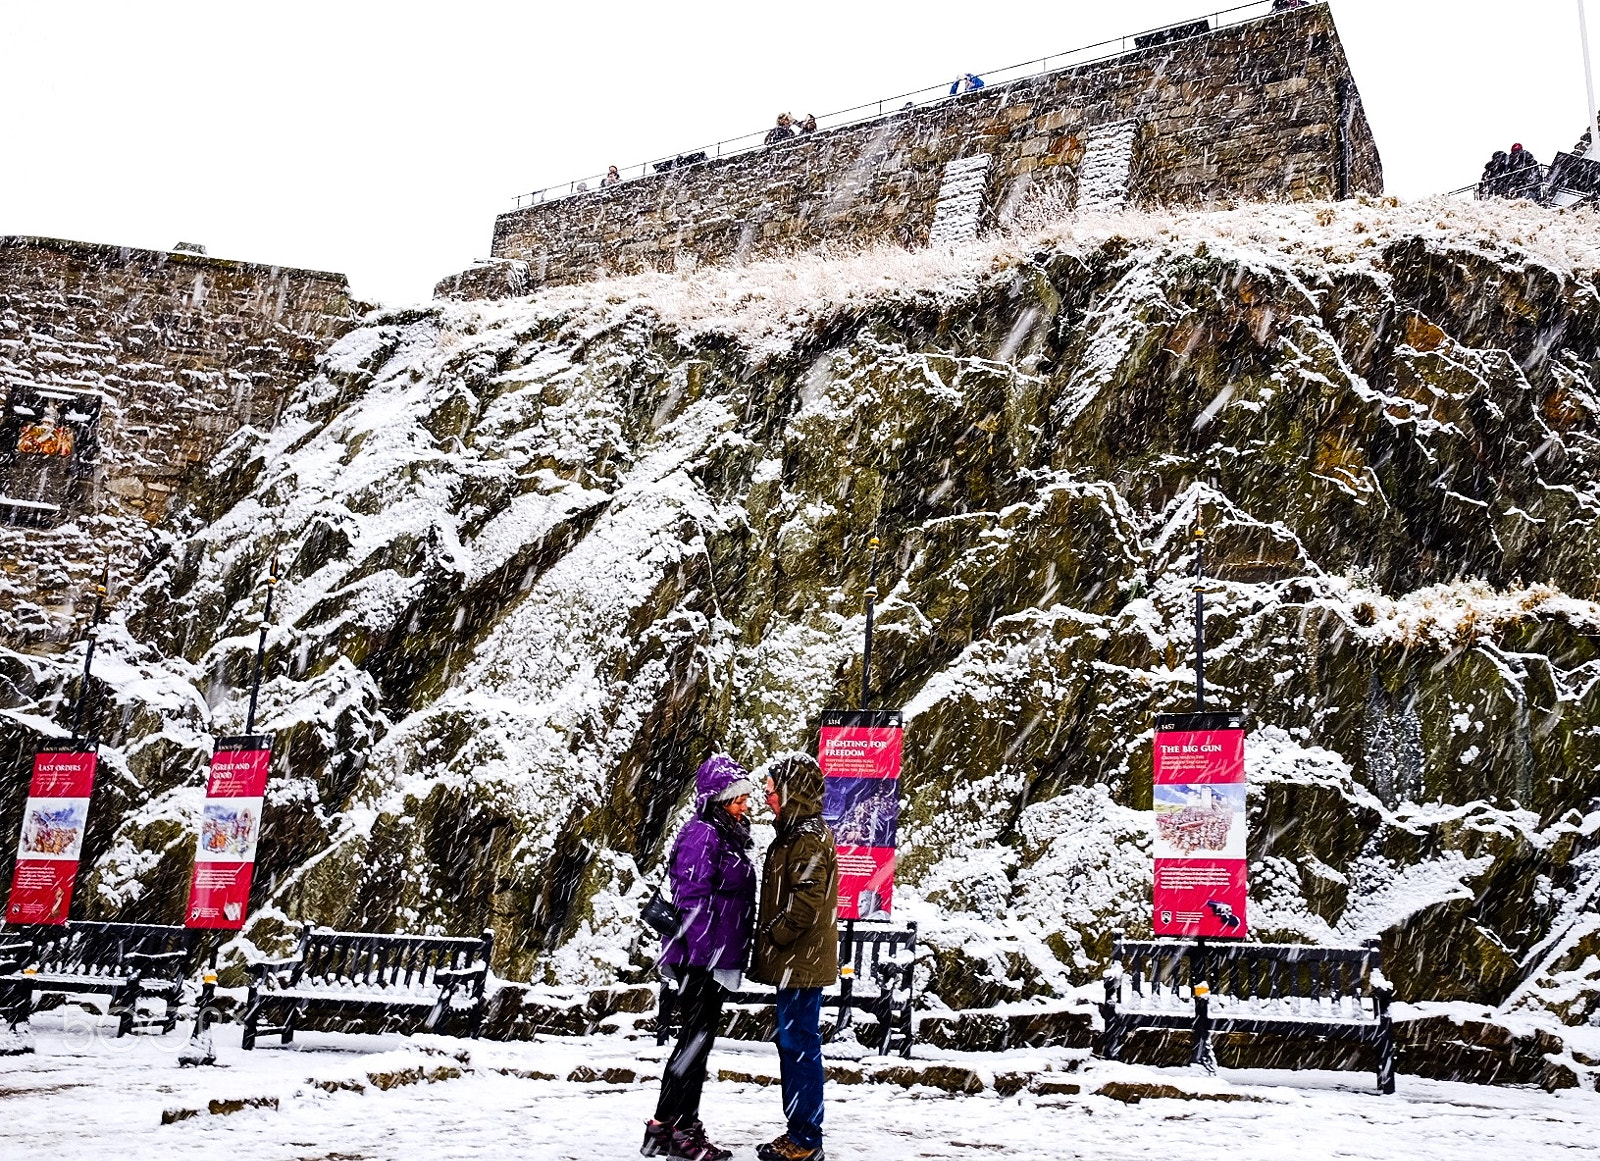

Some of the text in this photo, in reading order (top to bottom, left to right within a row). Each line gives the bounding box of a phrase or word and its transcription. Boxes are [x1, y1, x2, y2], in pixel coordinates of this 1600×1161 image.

[826, 739, 887, 748] FIGHTING FOR
[825, 749, 865, 757] FREEDOM
[1160, 744, 1222, 753] THE BIG GUN
[38, 763, 81, 772] LAST ORDERS
[213, 762, 250, 771] GREAT AND
[212, 771, 233, 779] GOOD
